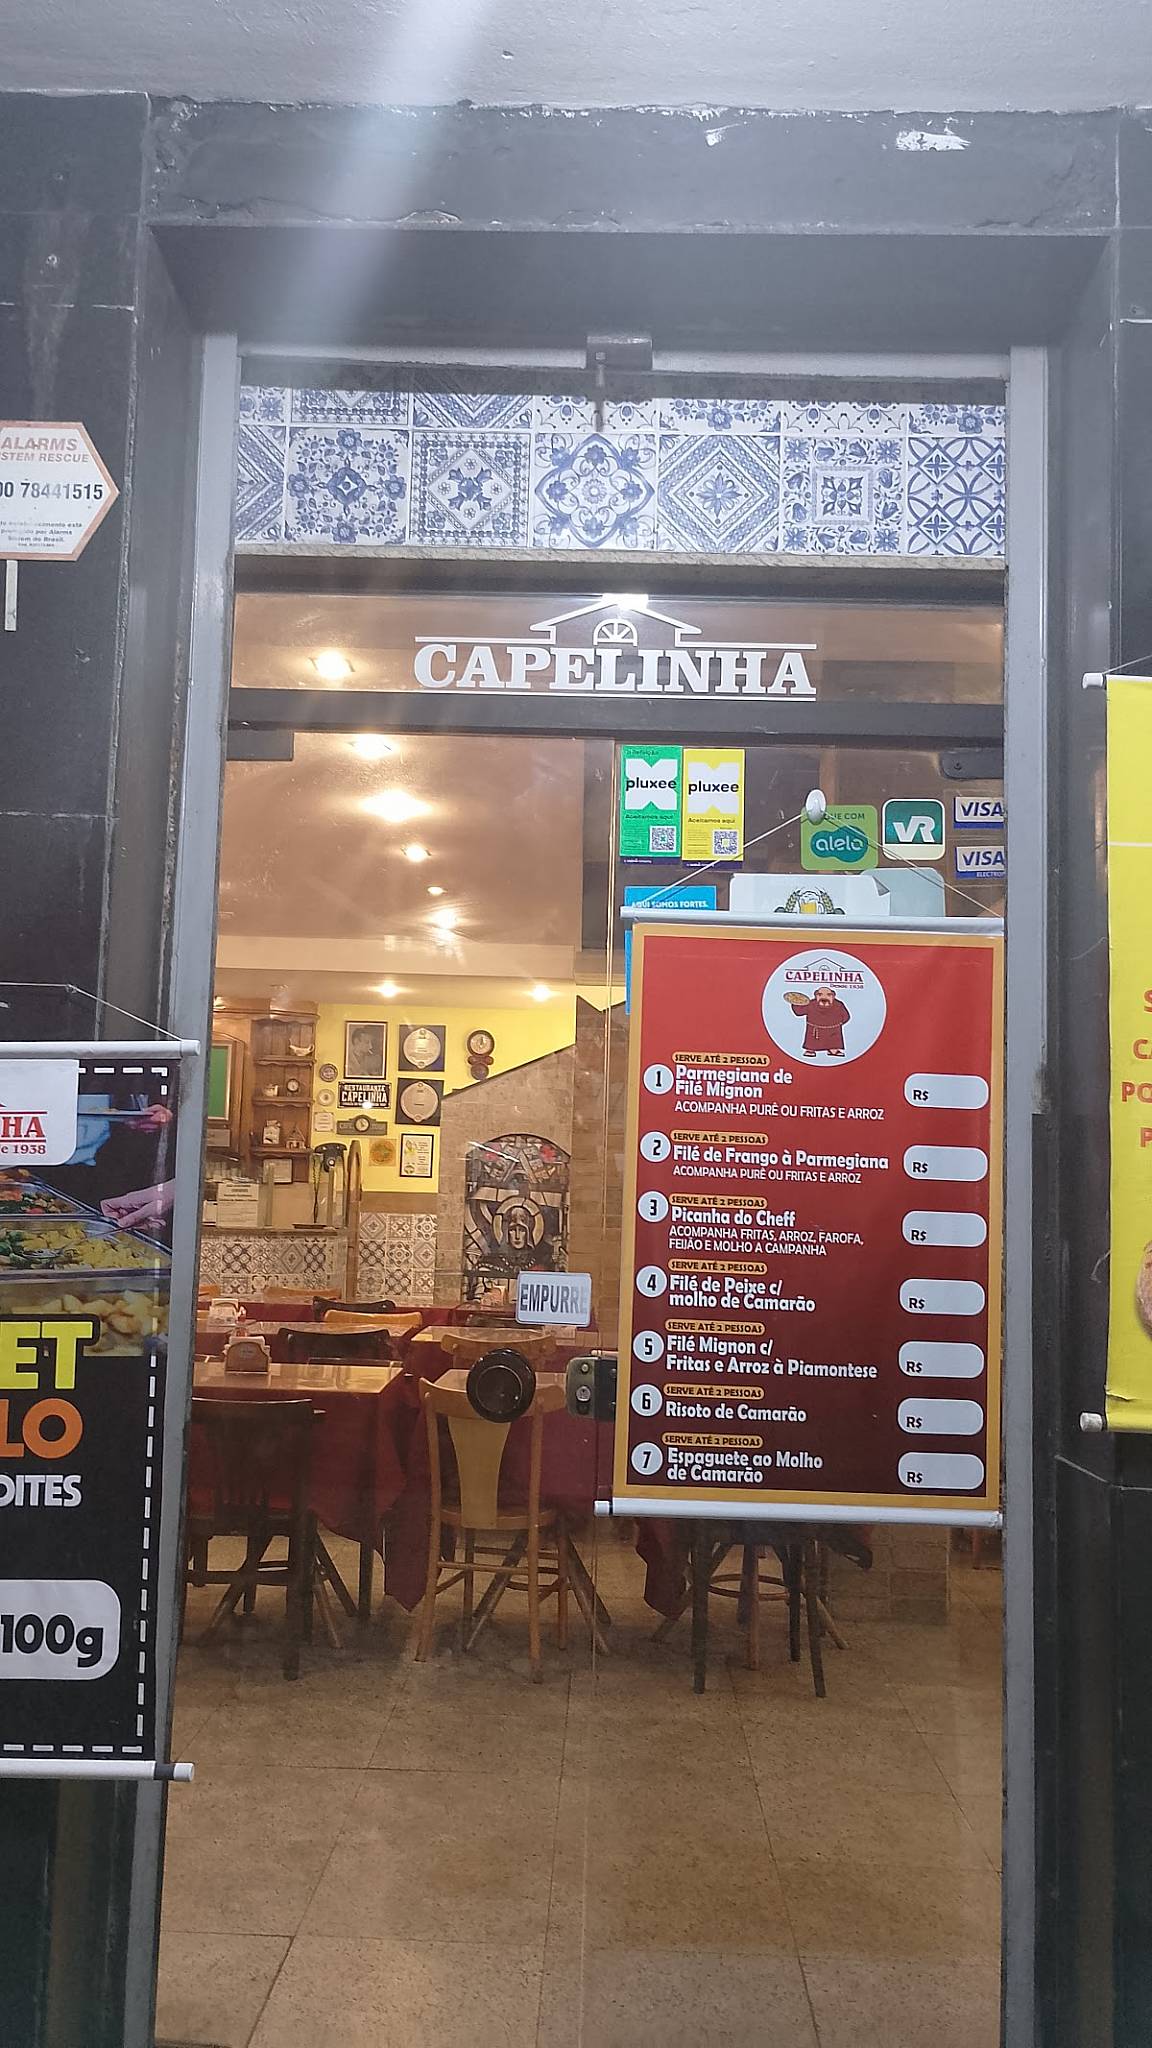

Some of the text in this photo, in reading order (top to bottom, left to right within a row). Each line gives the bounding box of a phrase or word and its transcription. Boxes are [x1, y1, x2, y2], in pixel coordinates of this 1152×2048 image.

[0, 437, 77, 451] ALARMS
[40, 453, 89, 463] RESCUE
[20, 482, 103, 500] 78441515
[414, 644, 816, 694] CAPELINHA
[626, 777, 677, 792] pluxee
[688, 780, 739, 795] pluxee
[844, 812, 865, 820] COM
[961, 802, 1004, 816] VISA
[893, 815, 935, 843] VR
[815, 836, 864, 851] alelo
[962, 851, 1005, 865] VISA
[785, 971, 863, 982] CAPELINHA
[675, 1054, 767, 1065] SERVE ATÉ 2 PESSOAS
[655, 1071, 662, 1087] 1
[675, 1065, 793, 1085] Parmegiana de
[344, 1084, 386, 1092] RESTAURANTE
[675, 1080, 762, 1099] Filé Mignon
[913, 1089, 929, 1101] R$
[341, 1091, 388, 1103] CAPELINHA
[675, 1101, 884, 1120] ACOMPANHA PURÊ OU FRITAS E ARROZ
[673, 1132, 766, 1144] SERVE ATÉ 2 PESSOAS
[653, 1139, 661, 1156] 2
[673, 1144, 889, 1170] Filé de Frango à Parmegiana
[673, 1165, 861, 1183] ACOMPANHA PURÊ OU FRITAS E ARROZ
[912, 1161, 928, 1173] R$
[650, 1199, 657, 1216] 3
[671, 1195, 698, 1205] SERVE
[700, 1196, 718, 1205] ATÉ
[727, 1199, 765, 1207] PESSOAS
[671, 1206, 796, 1227] Picanha do Cheff
[669, 1226, 864, 1245] ACOMPANHA FRITAS, ARROZ, FAROFA,
[911, 1229, 927, 1242] R$
[669, 1238, 826, 1256] FEIJÃO E MOLHO A CAMPANHA
[671, 1262, 699, 1270] SERVE
[700, 1261, 718, 1271] ATÉ
[727, 1264, 765, 1273] PESSOAS
[647, 1274, 657, 1291] 4
[670, 1275, 783, 1296] Filé de Peixe c/
[669, 1292, 816, 1312] molho de Camarão
[908, 1297, 925, 1310] R$
[667, 1322, 762, 1334] SERVE ATÉ 2 PESSOAS
[644, 1338, 653, 1355] 5
[667, 1335, 773, 1356] Filé Mignon c/
[666, 1354, 878, 1378] Fritas e Arroz à Piamontese
[906, 1361, 923, 1374] R$
[666, 1386, 694, 1395] SERVE
[696, 1386, 715, 1396] ATÉ
[724, 1389, 762, 1398] PESSOAS
[641, 1392, 651, 1409] 6
[665, 1401, 807, 1422] Risoto de Camarão
[906, 1416, 923, 1429] R$
[664, 1435, 693, 1444] SERVE
[695, 1435, 713, 1445] ATÉ
[722, 1438, 760, 1447] PESSOAS
[643, 1451, 651, 1468] 7
[667, 1448, 824, 1469] Espaguete ao Molho
[666, 1464, 763, 1483] de Camarão
[906, 1471, 923, 1484] R$
[1, 1614, 104, 1668] 100g
